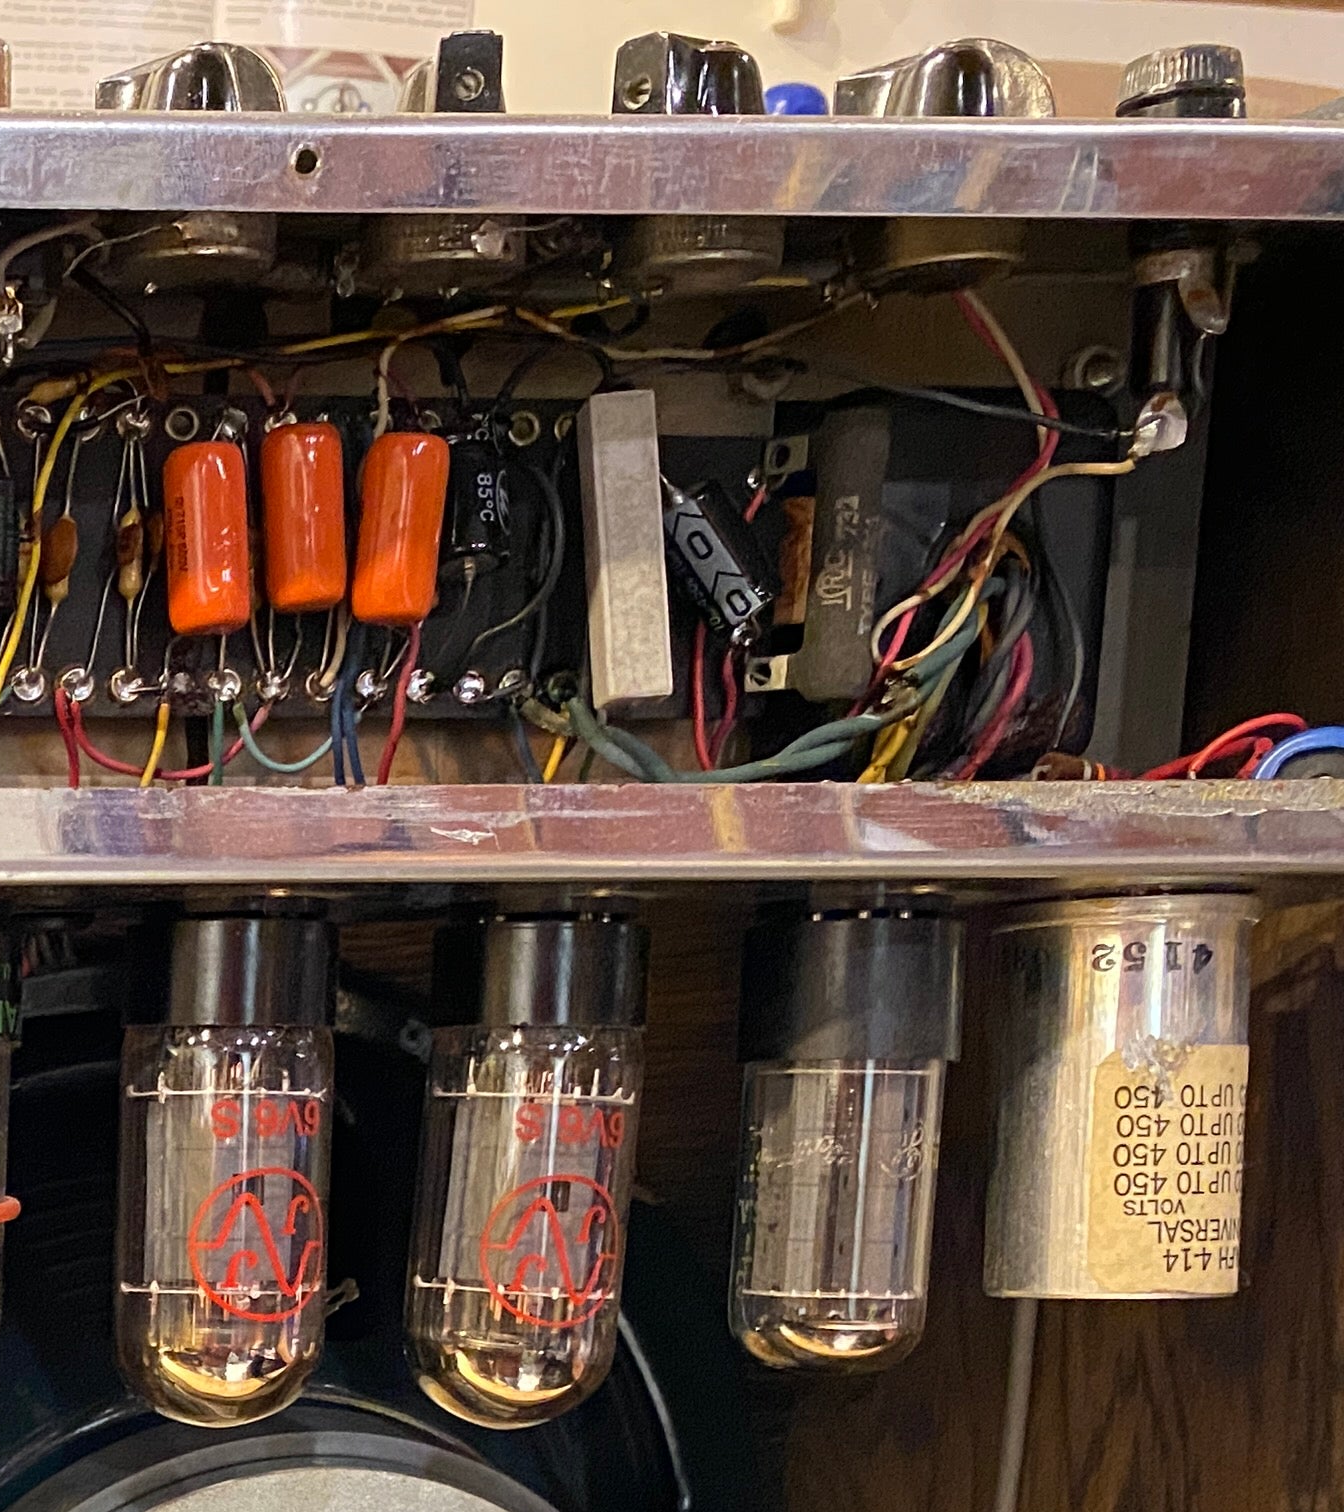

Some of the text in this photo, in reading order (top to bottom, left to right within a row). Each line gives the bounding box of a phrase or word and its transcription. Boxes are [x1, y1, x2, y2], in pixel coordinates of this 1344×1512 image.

[476, 473, 496, 522] 85°C
[1091, 942, 1213, 973] 4152
[211, 1100, 321, 1141] 6V6 S
[515, 1105, 626, 1148] 6V6 S
[1116, 1114, 1170, 1138] 450
[1113, 1143, 1167, 1167] 450
[1114, 1172, 1167, 1196] 450
[1123, 1199, 1185, 1216] VOLTS
[1147, 1218, 1239, 1243] NIVERSAL
[1219, 1247, 1239, 1269] FH
